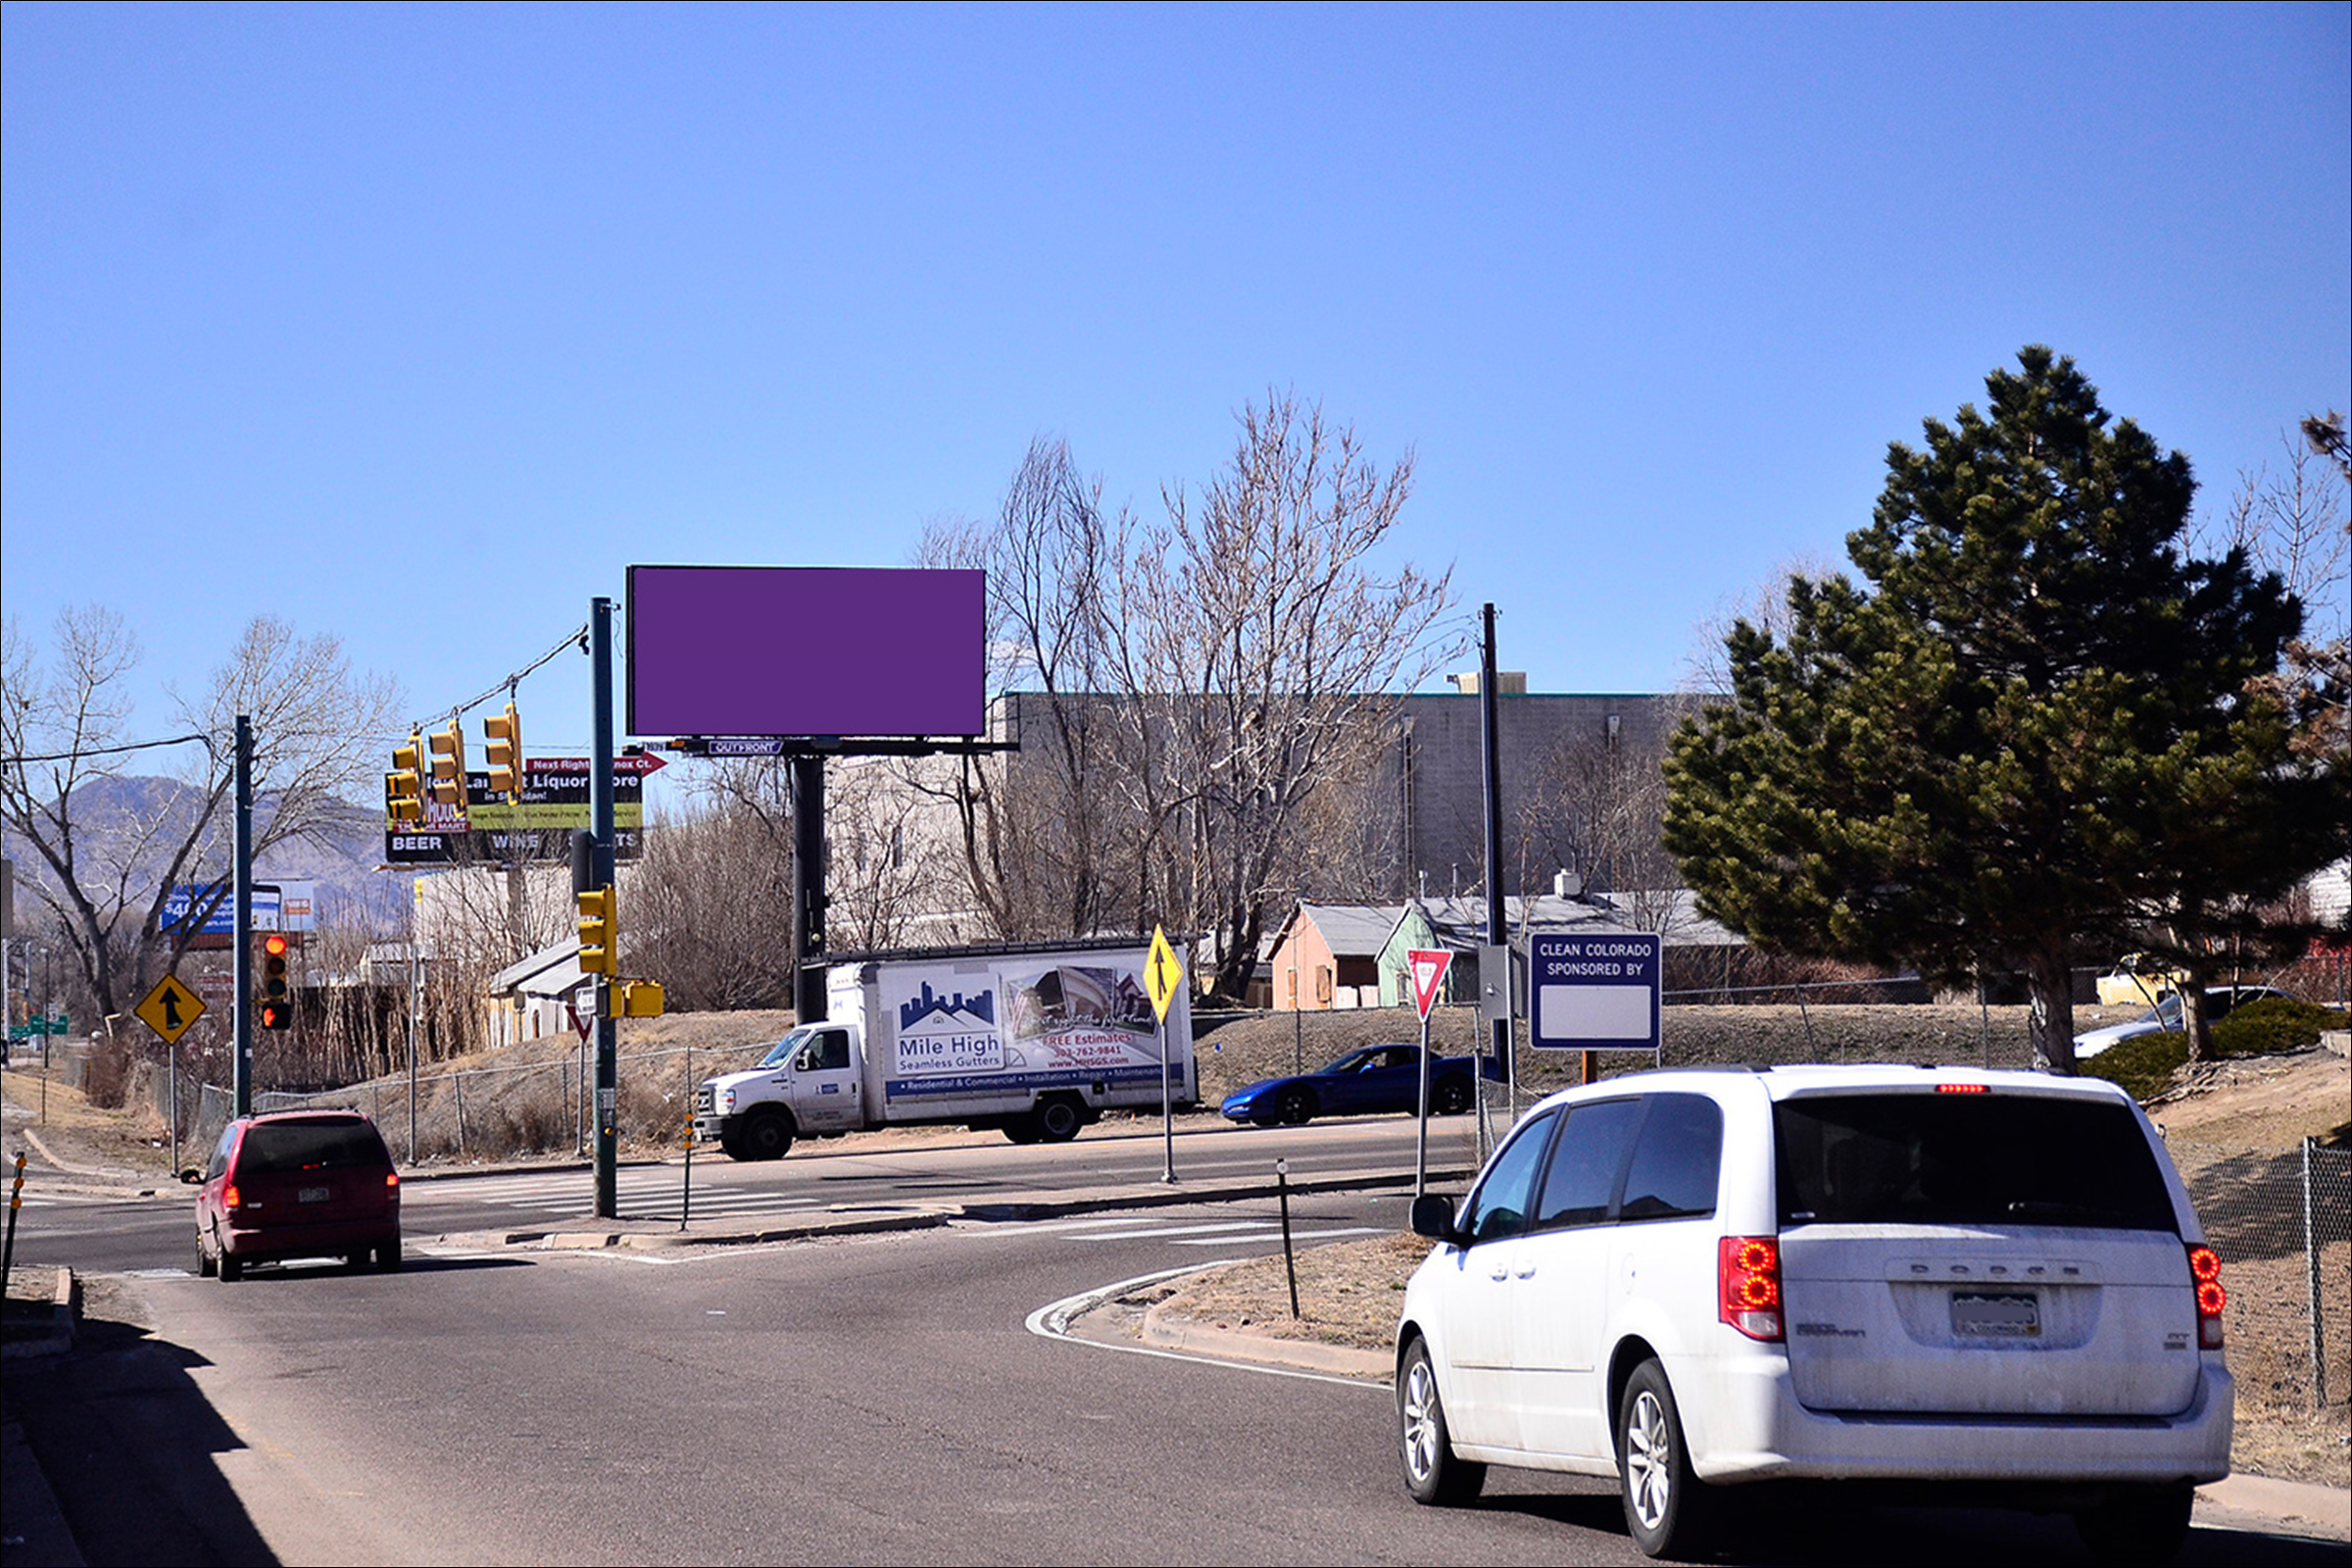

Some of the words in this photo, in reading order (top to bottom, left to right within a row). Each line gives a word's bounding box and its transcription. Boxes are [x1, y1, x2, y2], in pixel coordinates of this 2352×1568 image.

[715, 741, 774, 753] OUTFRONT
[533, 760, 559, 769] Next
[561, 760, 591, 770] Right
[610, 760, 633, 769] nox
[635, 759, 652, 769] Ct.
[533, 773, 588, 790] Liquor
[392, 836, 442, 851] BEER
[492, 834, 539, 849] WINE
[1540, 943, 1581, 956] CLEAN
[1586, 943, 1651, 956] COLORADO
[1547, 962, 1621, 976] SPONSORED
[1627, 962, 1644, 976] BY
[900, 1038, 943, 1056] Mile
[952, 1034, 999, 1056] High
[1043, 1035, 1071, 1046] FREE
[1075, 1032, 1132, 1045] Estimates
[1054, 1046, 1122, 1058] 303-762-9841
[900, 1059, 953, 1070] Seamless
[956, 1056, 1000, 1067] Gutters
[906, 1078, 955, 1090] Residential
[956, 1078, 963, 1087] &
[964, 1075, 1016, 1087] Commercial
[1024, 1072, 1073, 1082] Installation
[1078, 1069, 1107, 1080] Repair
[1113, 1066, 1163, 1077] Maintenanc
